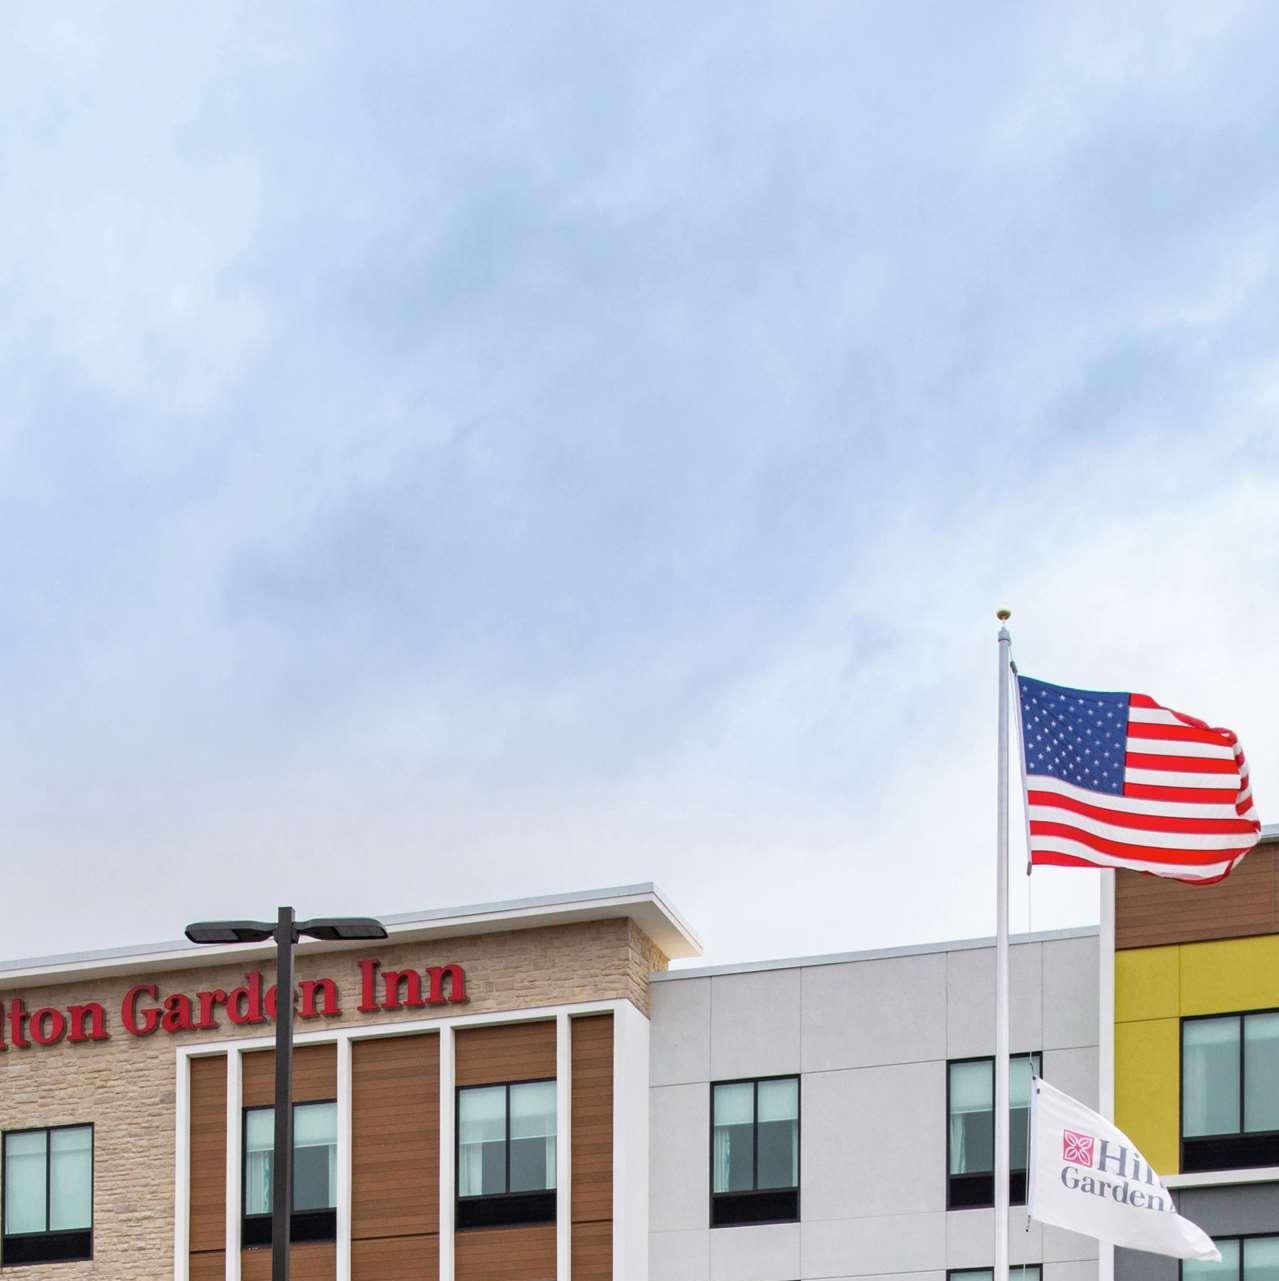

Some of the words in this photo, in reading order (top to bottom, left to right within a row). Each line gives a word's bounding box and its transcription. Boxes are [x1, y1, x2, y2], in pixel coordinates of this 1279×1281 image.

[357, 959, 469, 1013] Inn
[1097, 1138, 1165, 1188] Hil
[1061, 1166, 1164, 1212] Garden
